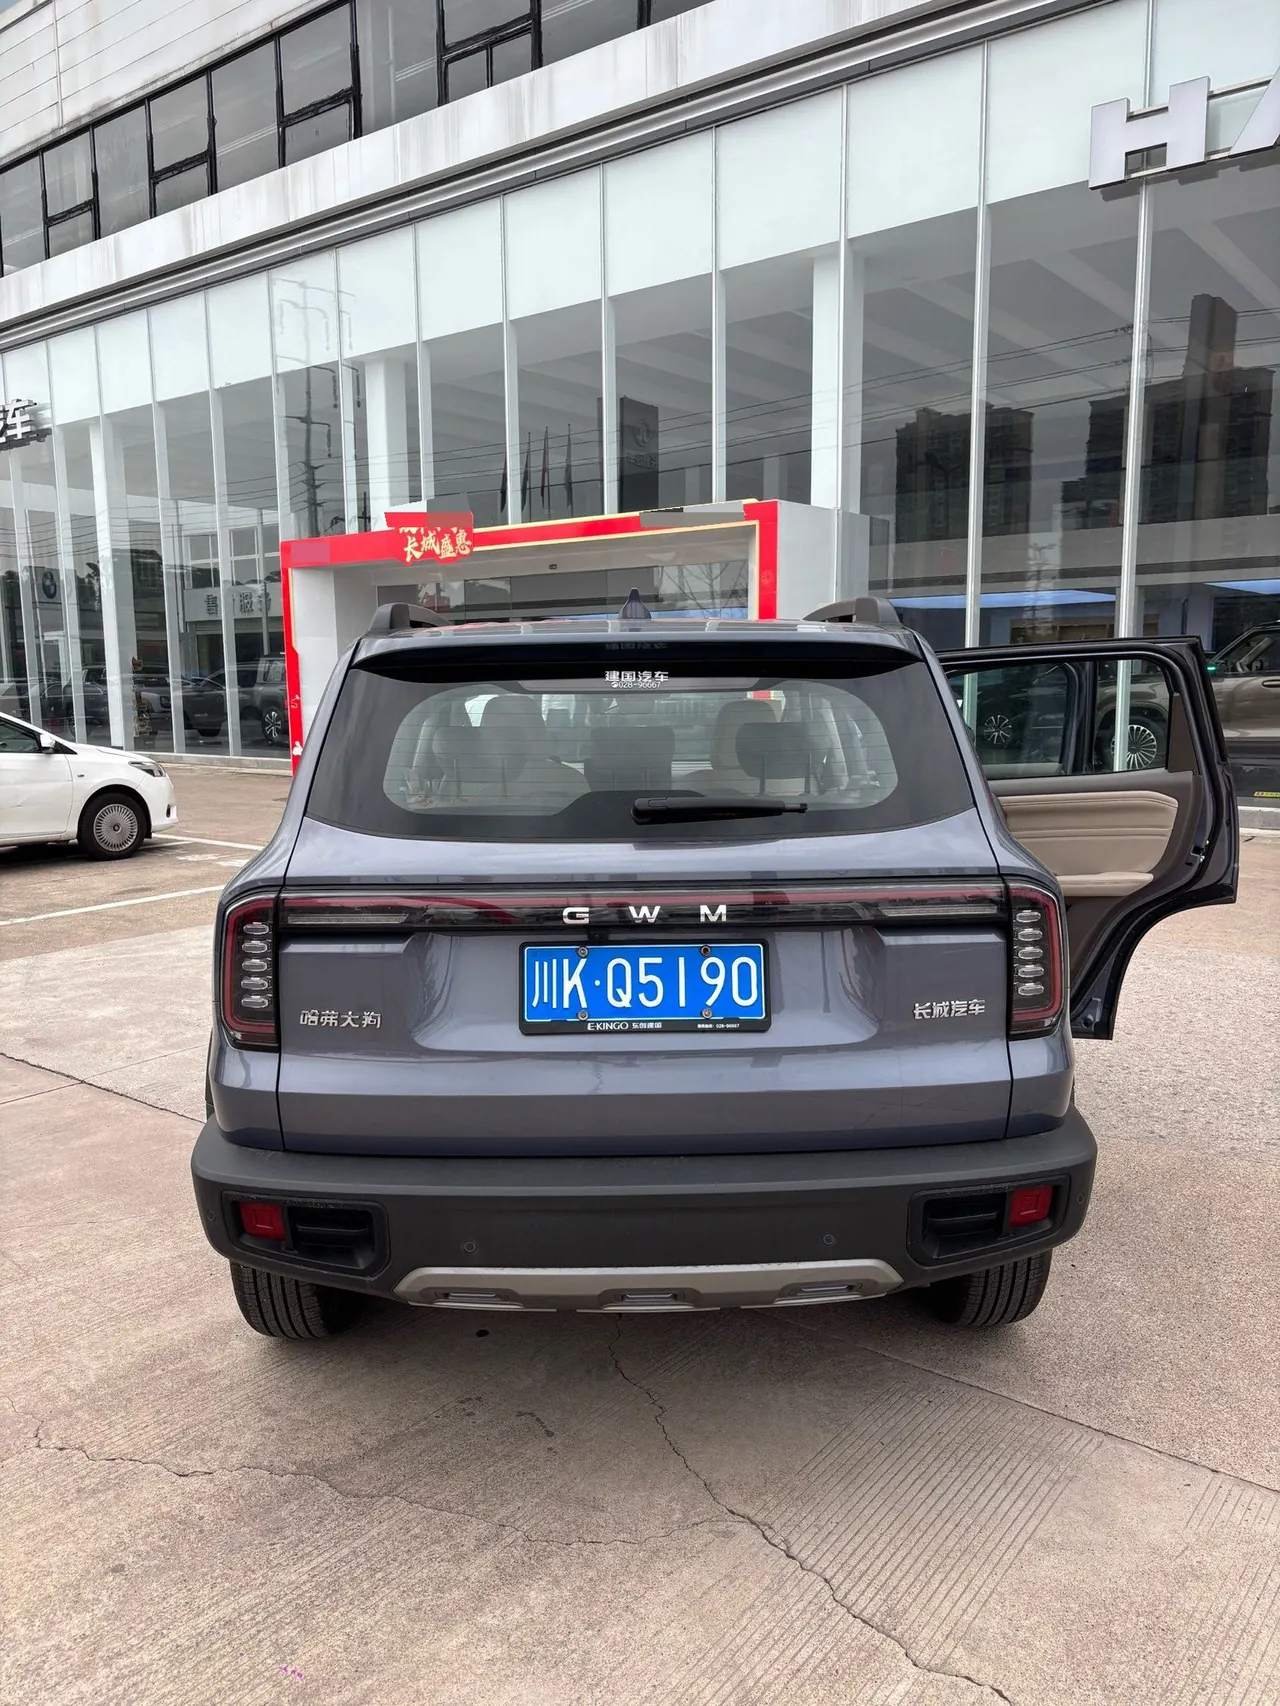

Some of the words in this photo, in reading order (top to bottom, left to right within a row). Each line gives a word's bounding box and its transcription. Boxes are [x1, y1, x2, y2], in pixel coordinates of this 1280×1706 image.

[403, 529, 472, 562] 长城盛惠
[605, 670, 669, 682] 建国汽车
[562, 904, 727, 925] GWM
[913, 998, 986, 1020] 长城汽车
